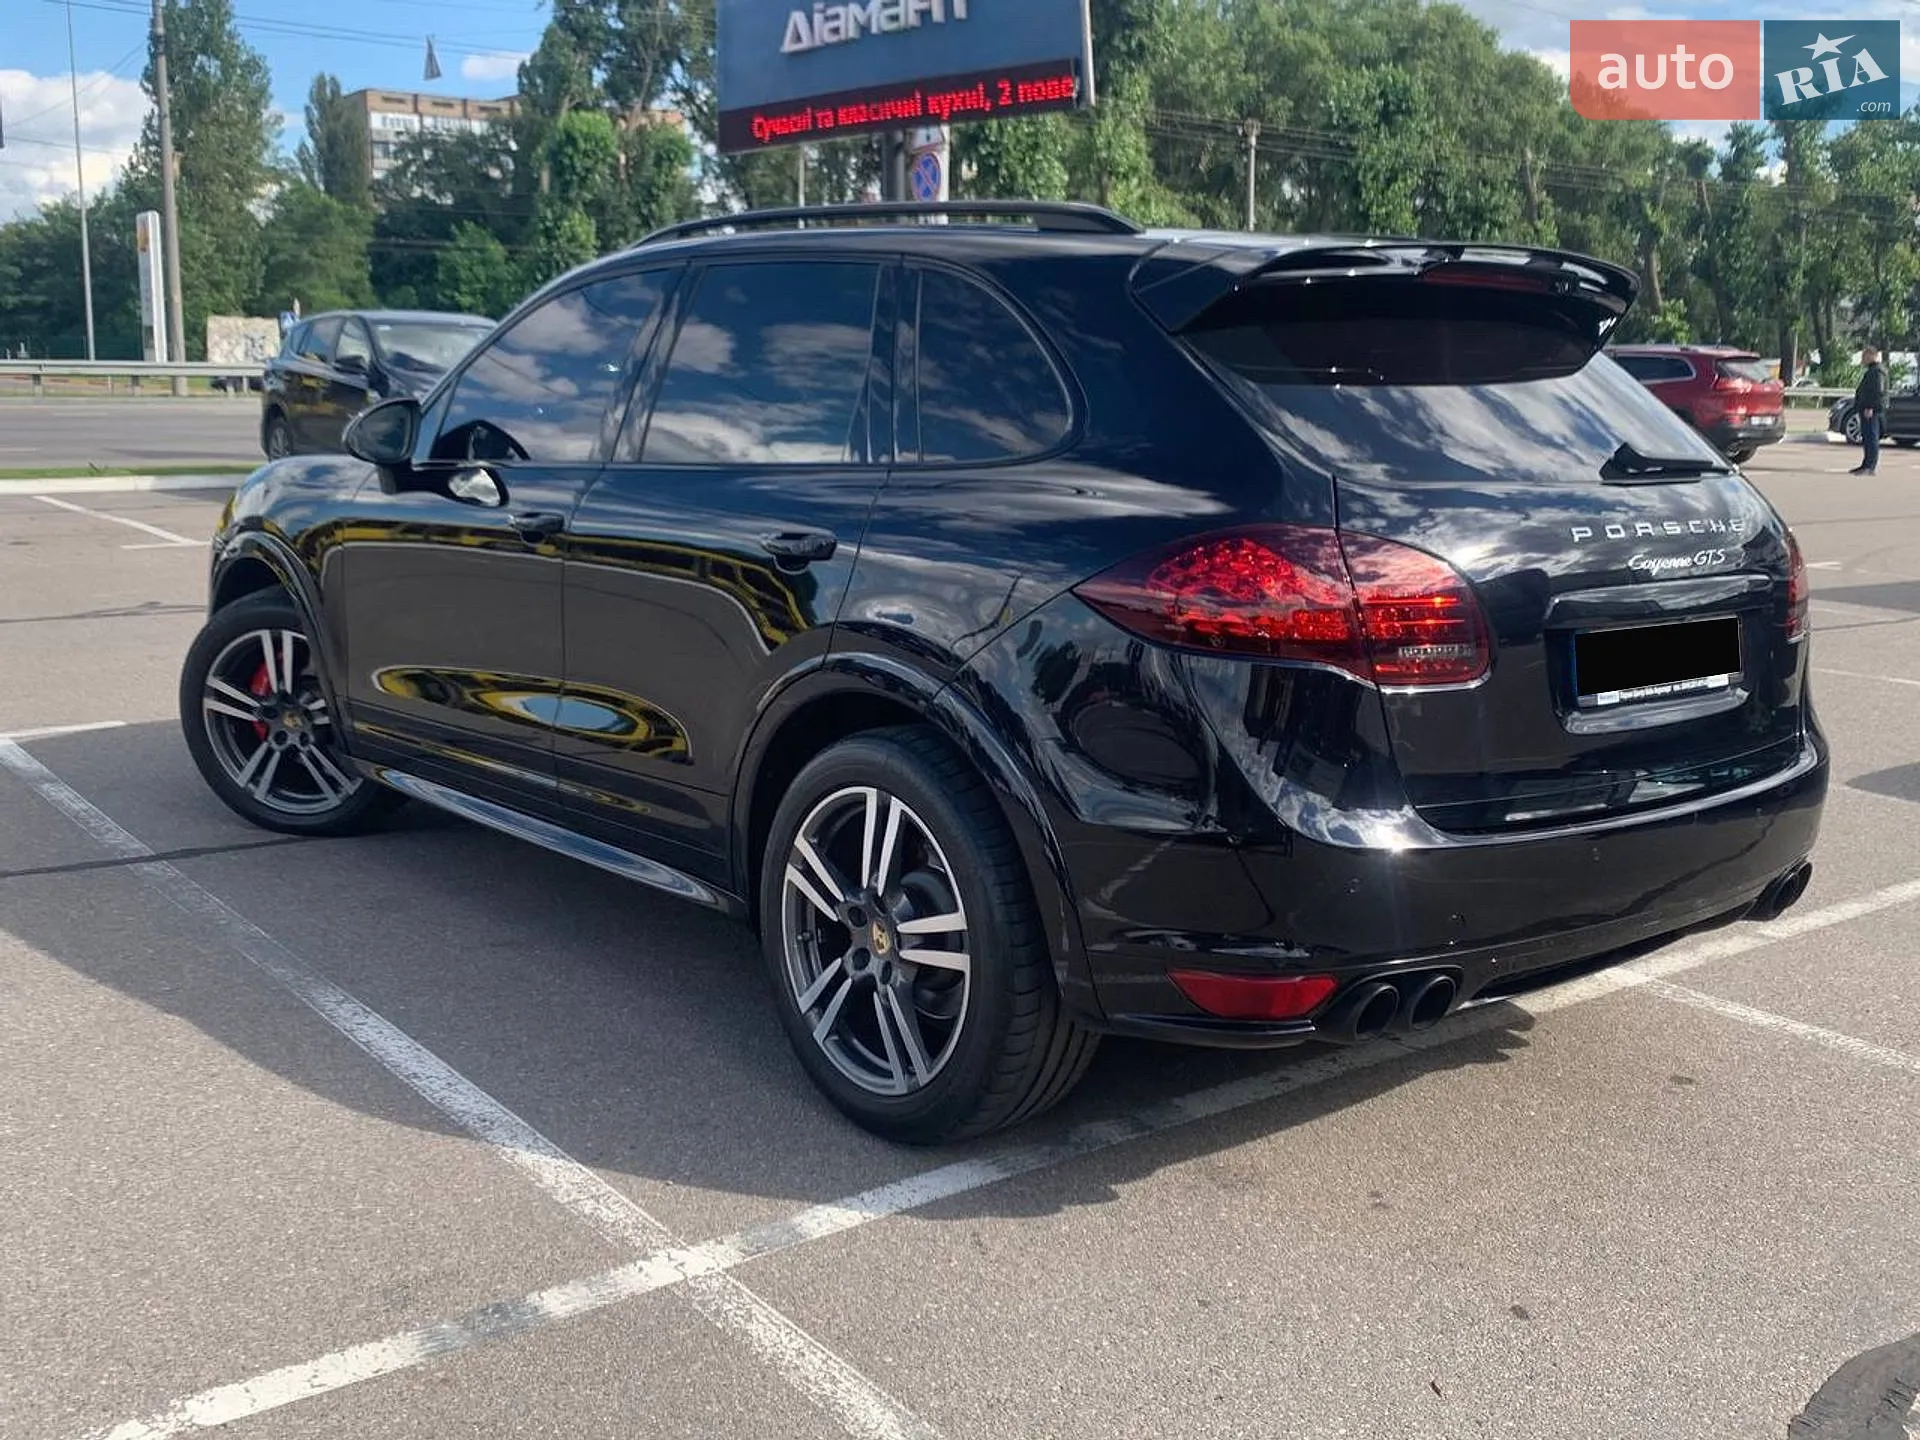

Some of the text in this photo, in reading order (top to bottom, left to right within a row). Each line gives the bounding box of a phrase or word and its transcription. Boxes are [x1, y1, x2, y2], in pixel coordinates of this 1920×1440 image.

[997, 78, 1013, 106] 2
[1570, 518, 1747, 543] PORSCHE
[1627, 548, 1726, 577] Cayenne GTS
